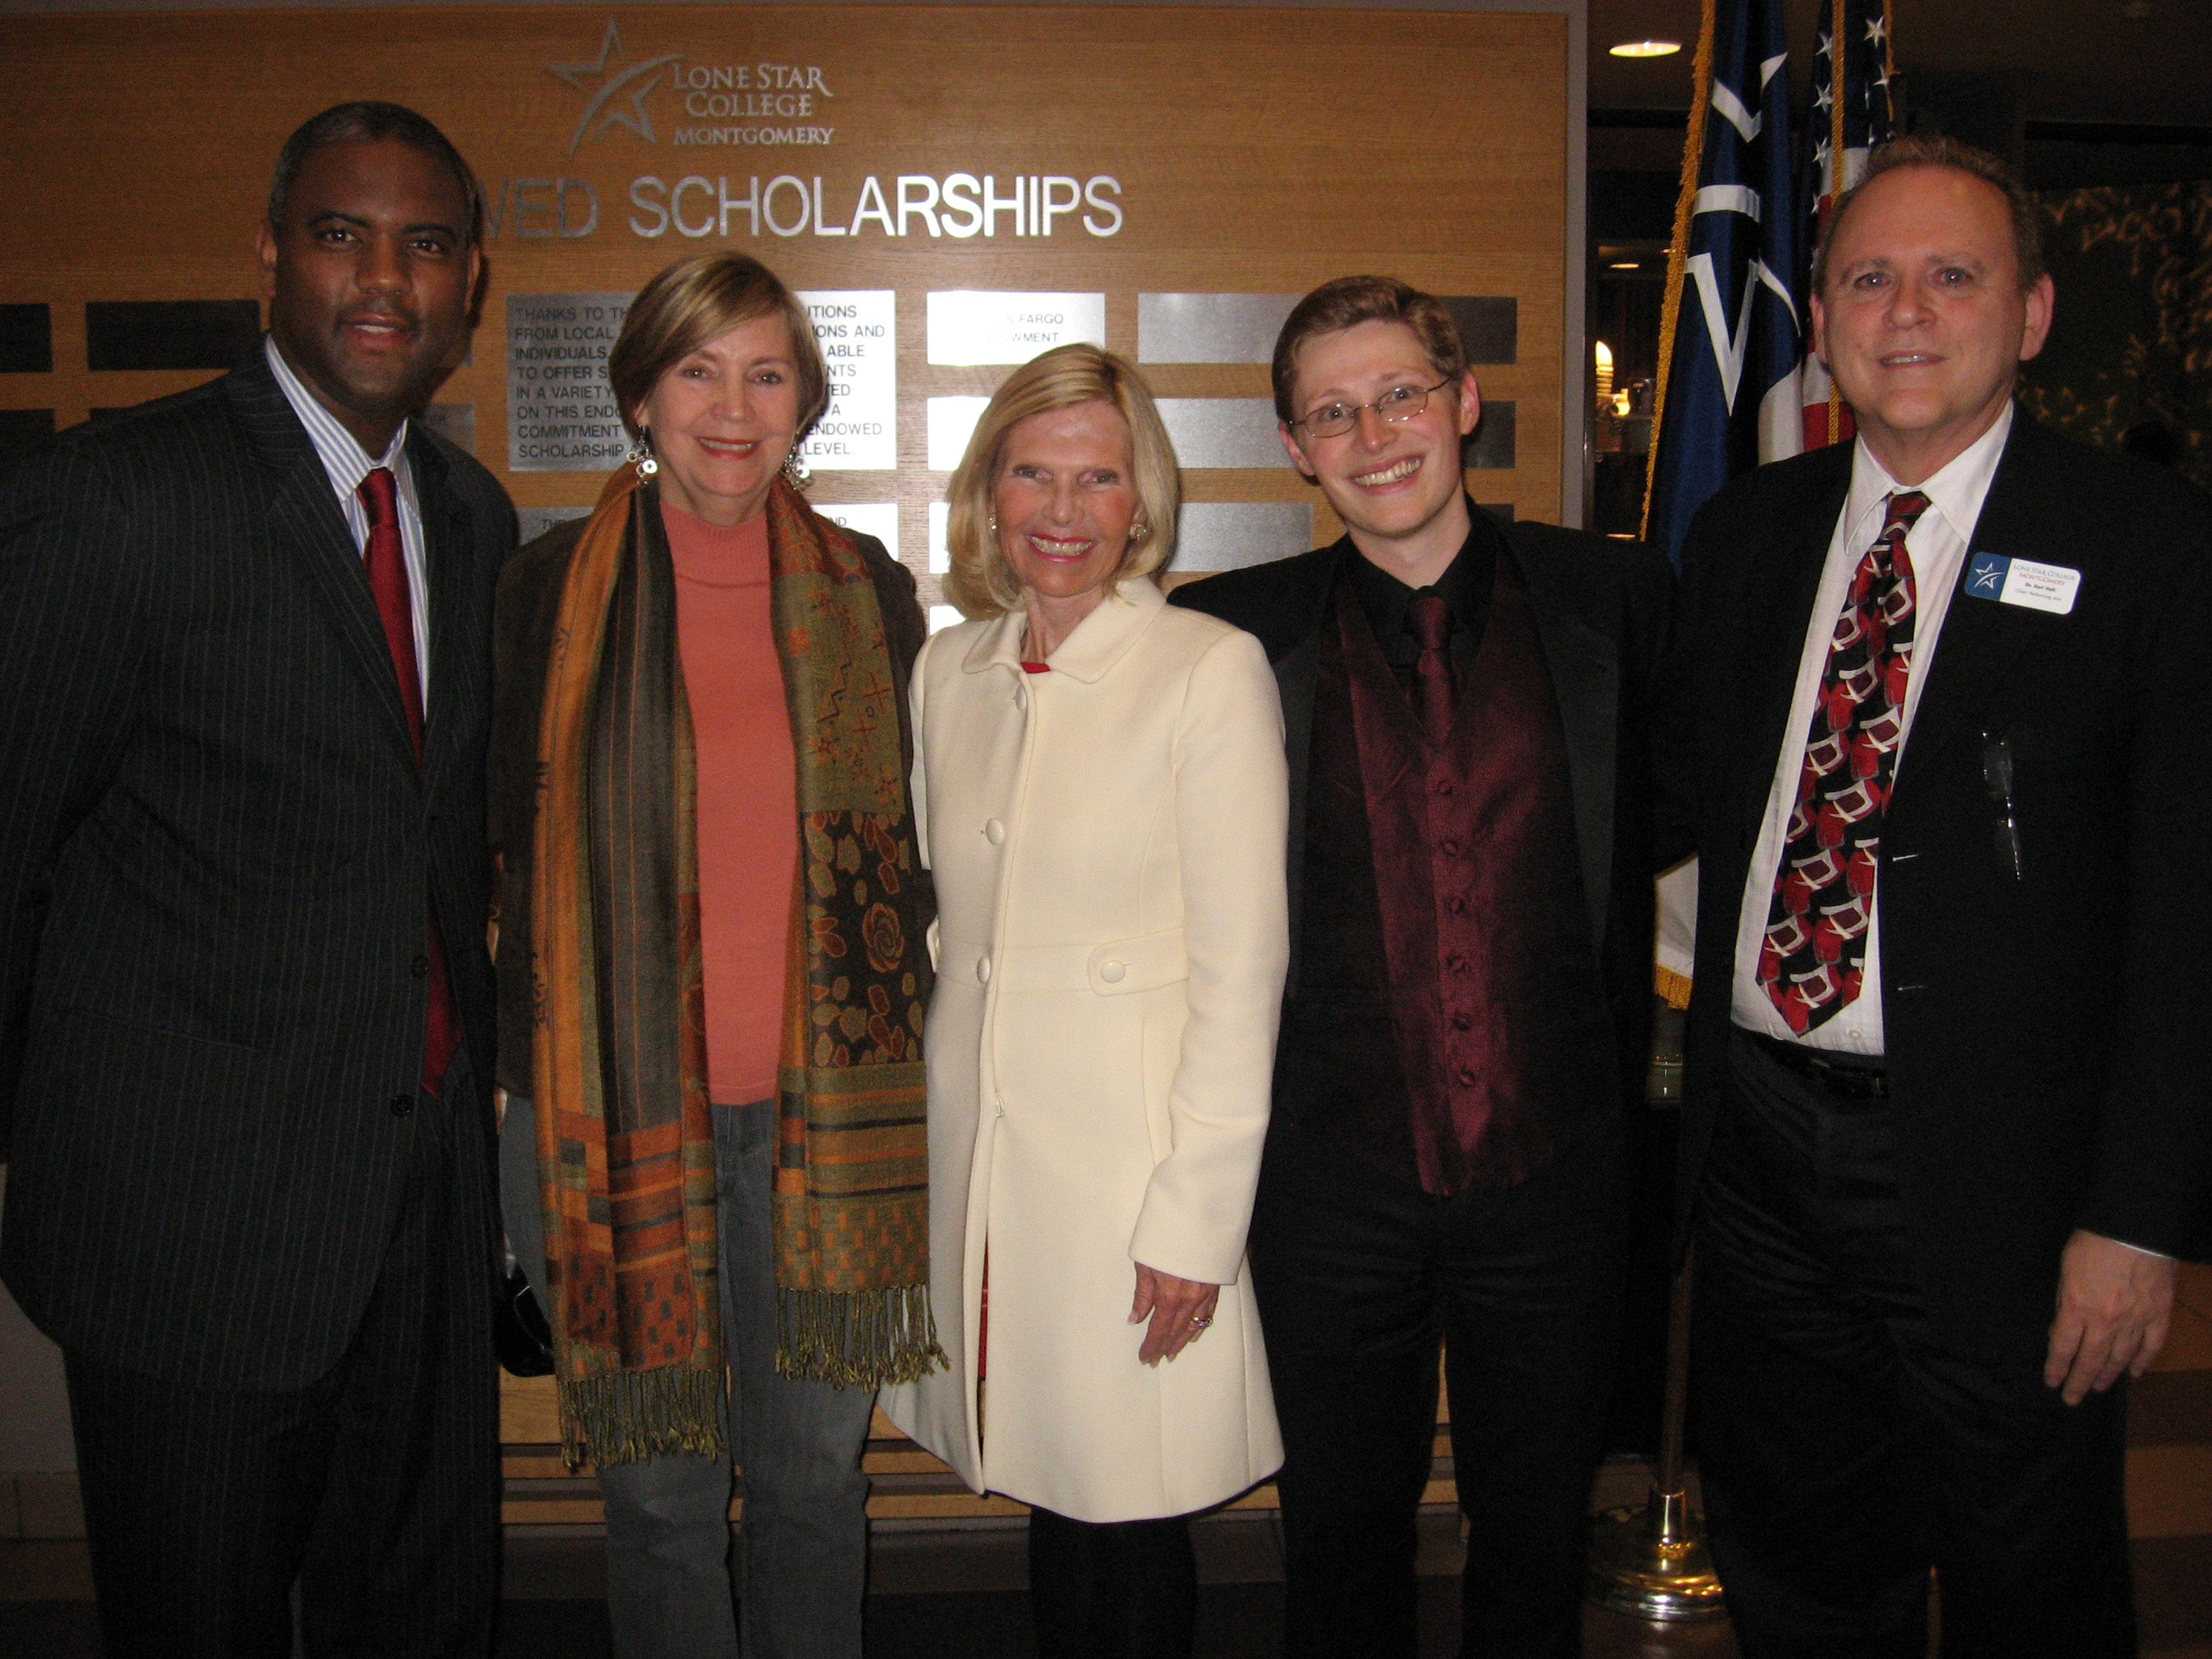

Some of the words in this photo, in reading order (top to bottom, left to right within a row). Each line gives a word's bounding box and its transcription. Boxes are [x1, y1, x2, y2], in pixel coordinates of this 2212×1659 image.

[673, 63, 750, 90] LONE
[757, 63, 834, 97] STAR
[685, 90, 812, 117] COLLEGE
[672, 126, 837, 145] MONTGOMERY
[630, 171, 1123, 239] SCHOLARSHIPS
[515, 306, 577, 321] THANKS
[584, 306, 604, 321] TO
[807, 305, 858, 319] TIONS
[1019, 313, 1064, 324] FARGO
[515, 327, 558, 341] FROM
[563, 326, 615, 340] LOCAL
[854, 324, 885, 338] AND
[826, 344, 866, 357] ABLE
[516, 366, 537, 379] TO
[543, 365, 592, 379] OFFER
[515, 386, 529, 399] IN
[537, 386, 547, 399] A
[551, 385, 612, 399] VARIETY
[517, 406, 539, 419] ON
[544, 405, 579, 419] THIS
[518, 424, 621, 439] COMMITMENT
[518, 444, 624, 458] SCHOLARSHIP
